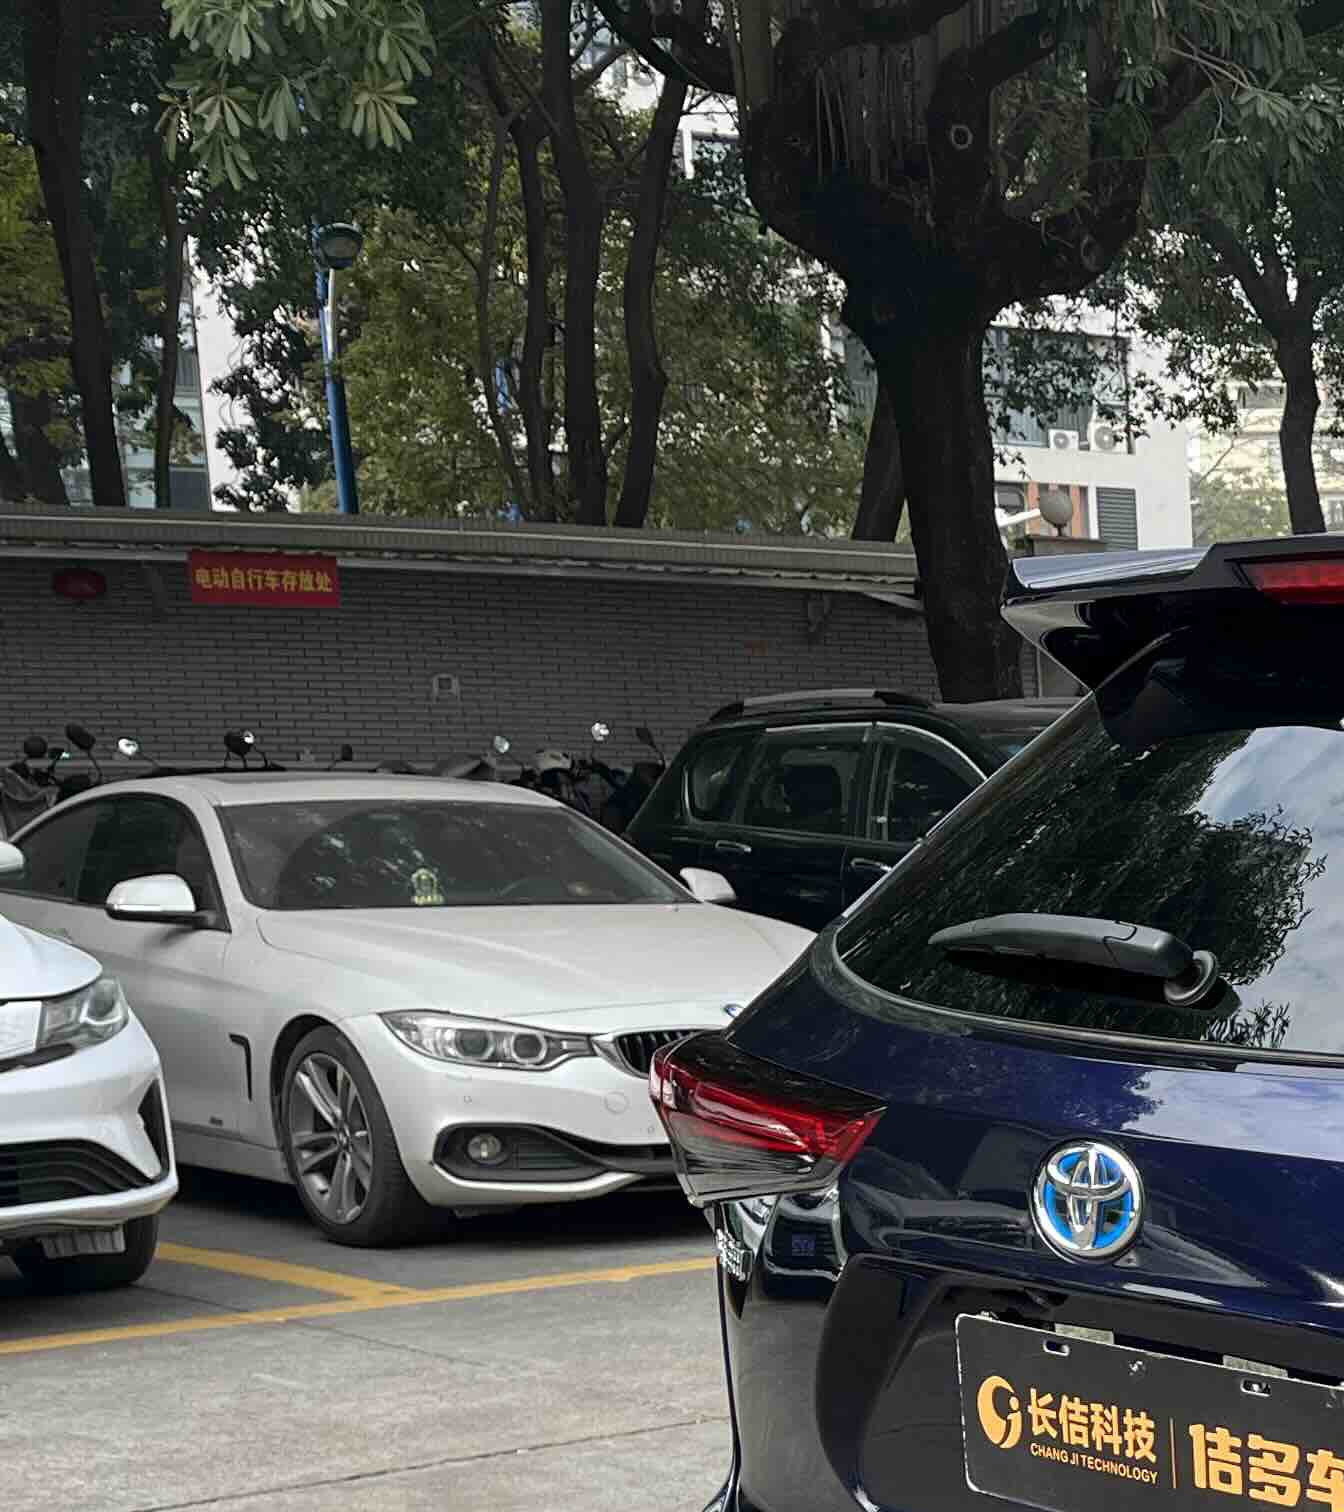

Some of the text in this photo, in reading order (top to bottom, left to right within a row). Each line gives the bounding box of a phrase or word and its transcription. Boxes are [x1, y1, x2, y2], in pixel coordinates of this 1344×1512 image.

[194, 565, 334, 593] 电动自行车存放处
[1079, 1454, 1159, 1485] TECHNOLOGY
